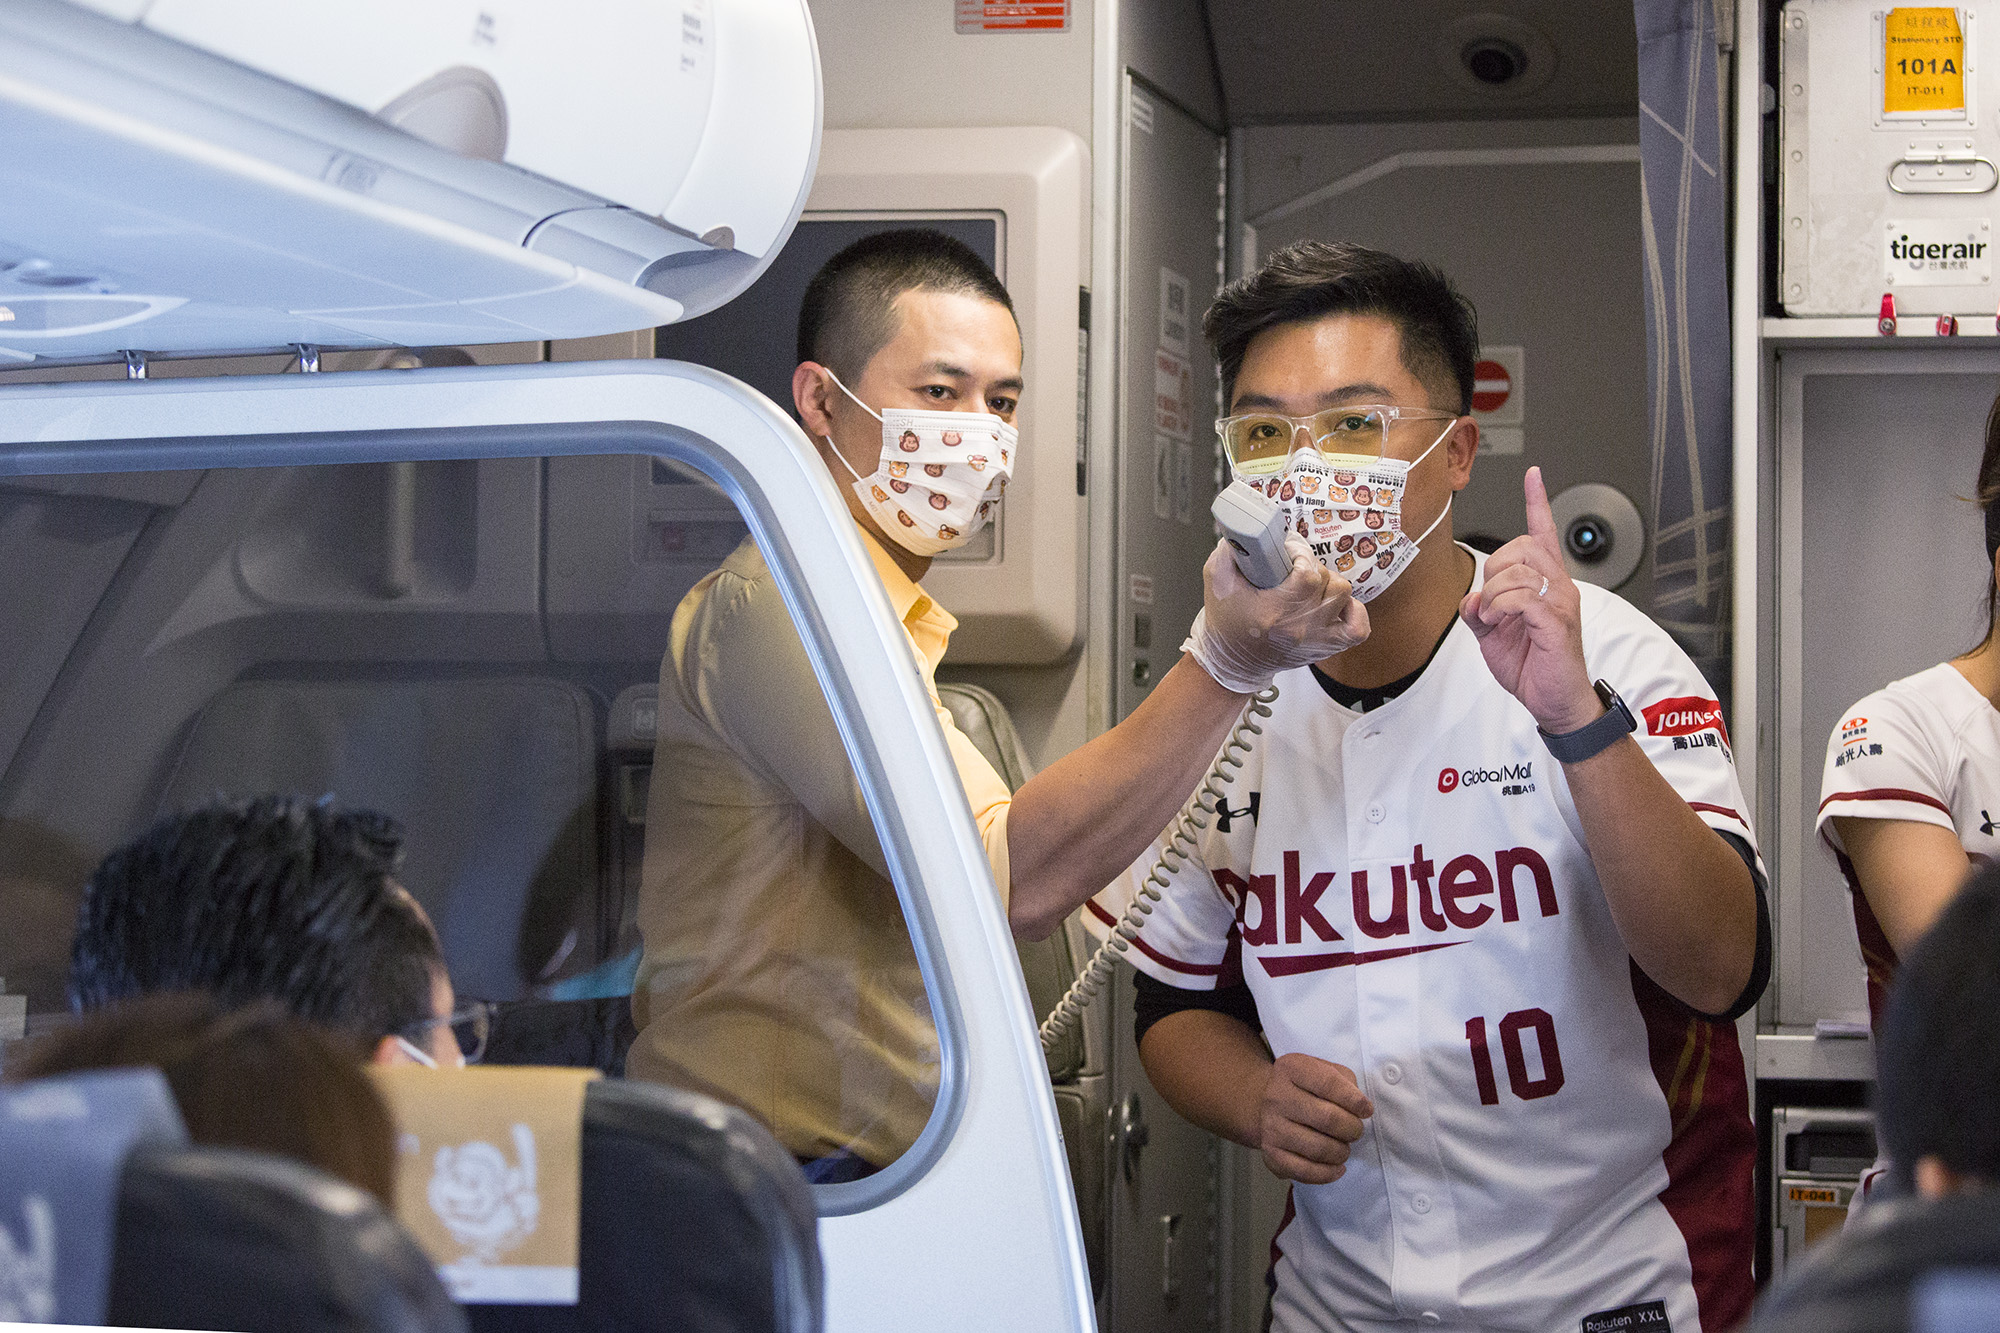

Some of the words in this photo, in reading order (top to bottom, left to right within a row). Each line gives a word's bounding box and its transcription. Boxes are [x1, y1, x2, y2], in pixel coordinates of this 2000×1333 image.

[1897, 58, 1957, 75] 101A
[1907, 86, 1945, 95] IT-011
[1890, 234, 1987, 270] tigerair
[1314, 524, 1343, 535] Rakuten
[1655, 709, 1725, 733] JOHNSO
[1465, 1006, 1566, 1106] 10
[1790, 1188, 1835, 1202] IT-041
[1586, 1315, 1632, 1332] Rakuten
[1638, 1309, 1664, 1323] XXL
